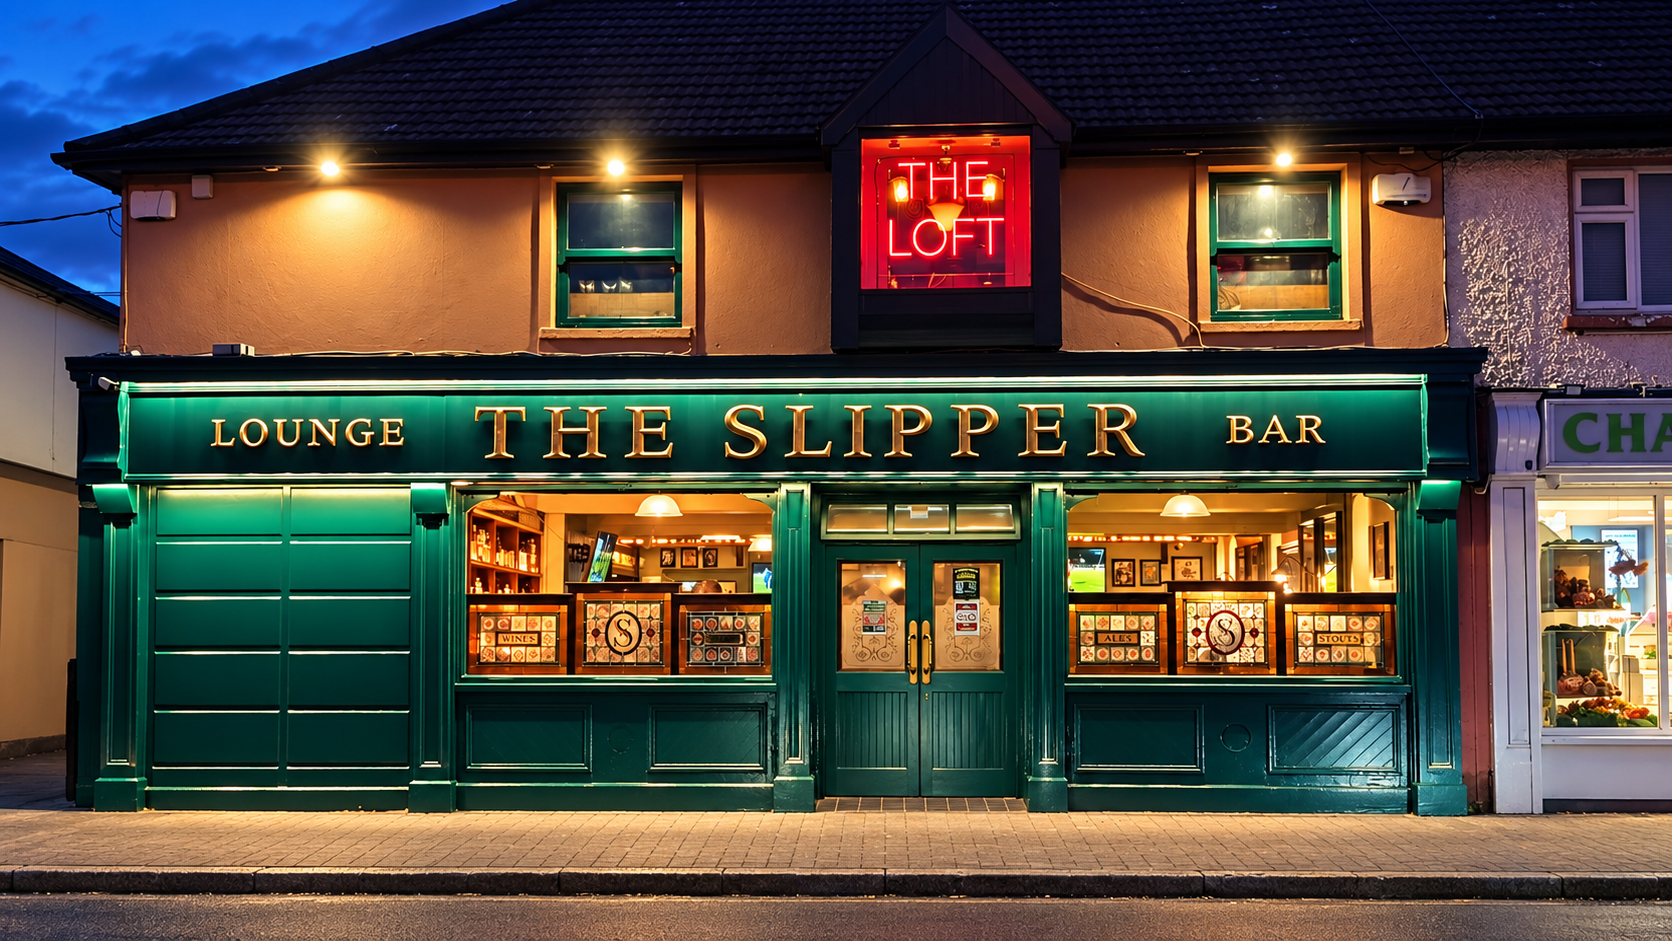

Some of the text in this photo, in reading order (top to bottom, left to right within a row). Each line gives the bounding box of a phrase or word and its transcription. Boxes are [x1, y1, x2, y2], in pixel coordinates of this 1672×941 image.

[898, 160, 988, 200] THE
[889, 217, 1005, 257] LOFT
[210, 418, 405, 448] LOUNGE
[474, 403, 1147, 460] THE SLIPPER
[1226, 414, 1327, 445] BAR
[502, 634, 537, 643] WINES
[1318, 635, 1360, 644] STOUTS
